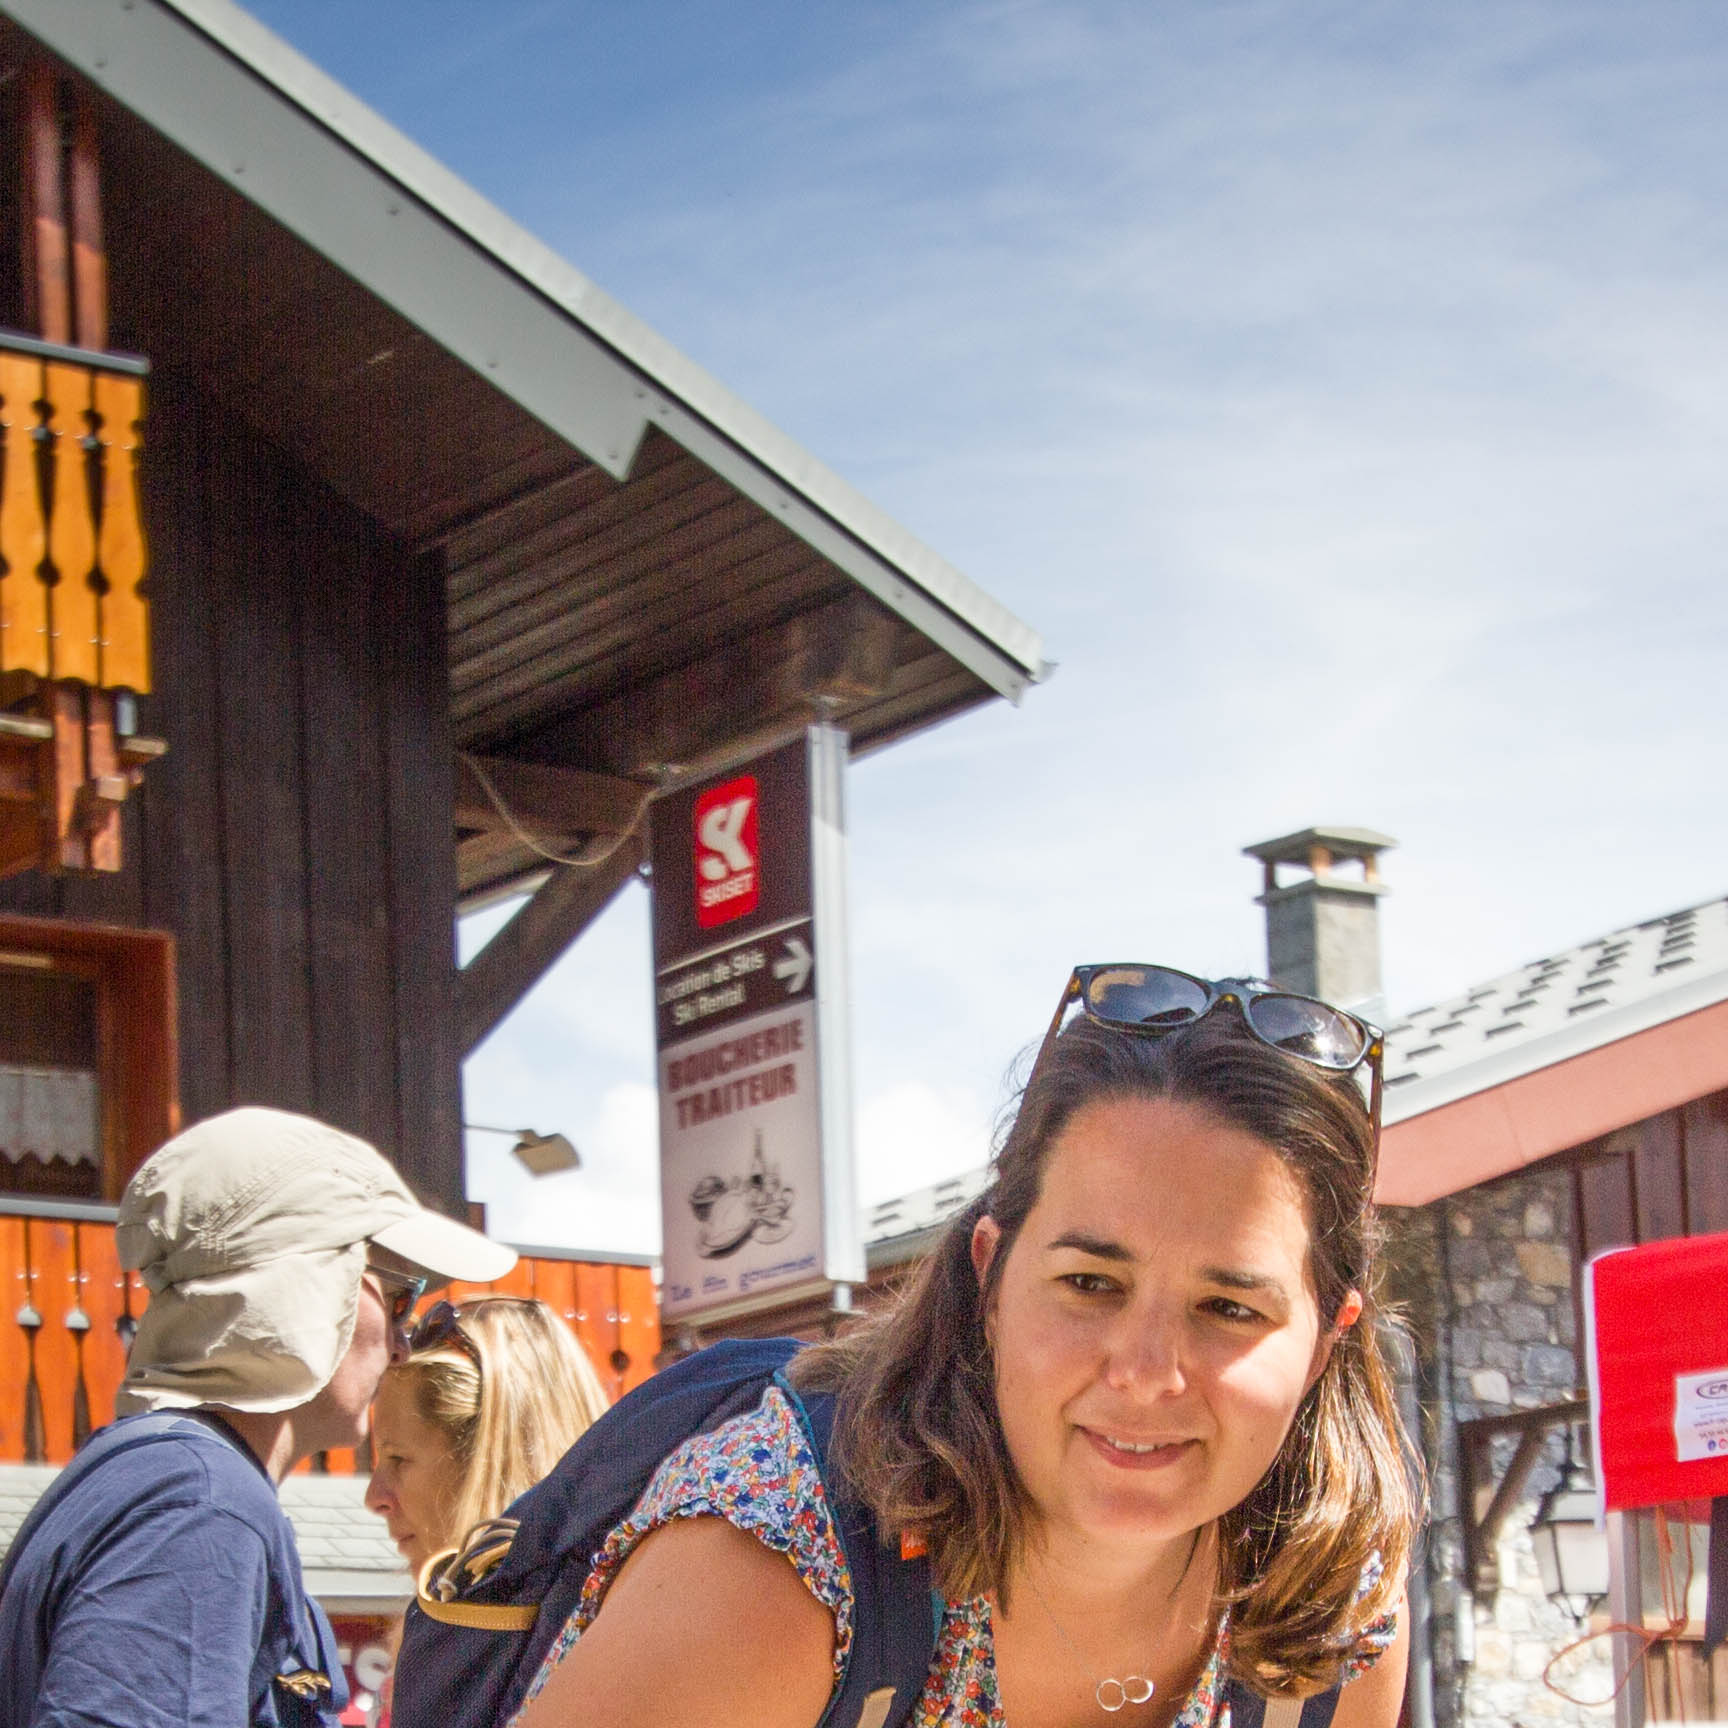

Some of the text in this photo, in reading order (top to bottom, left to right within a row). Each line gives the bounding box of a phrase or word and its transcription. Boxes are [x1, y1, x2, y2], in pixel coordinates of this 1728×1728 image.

[702, 873, 753, 908] SKISET
[667, 1018, 805, 1094] BOUCHERIE
[676, 1062, 798, 1131] TRAITEUR
